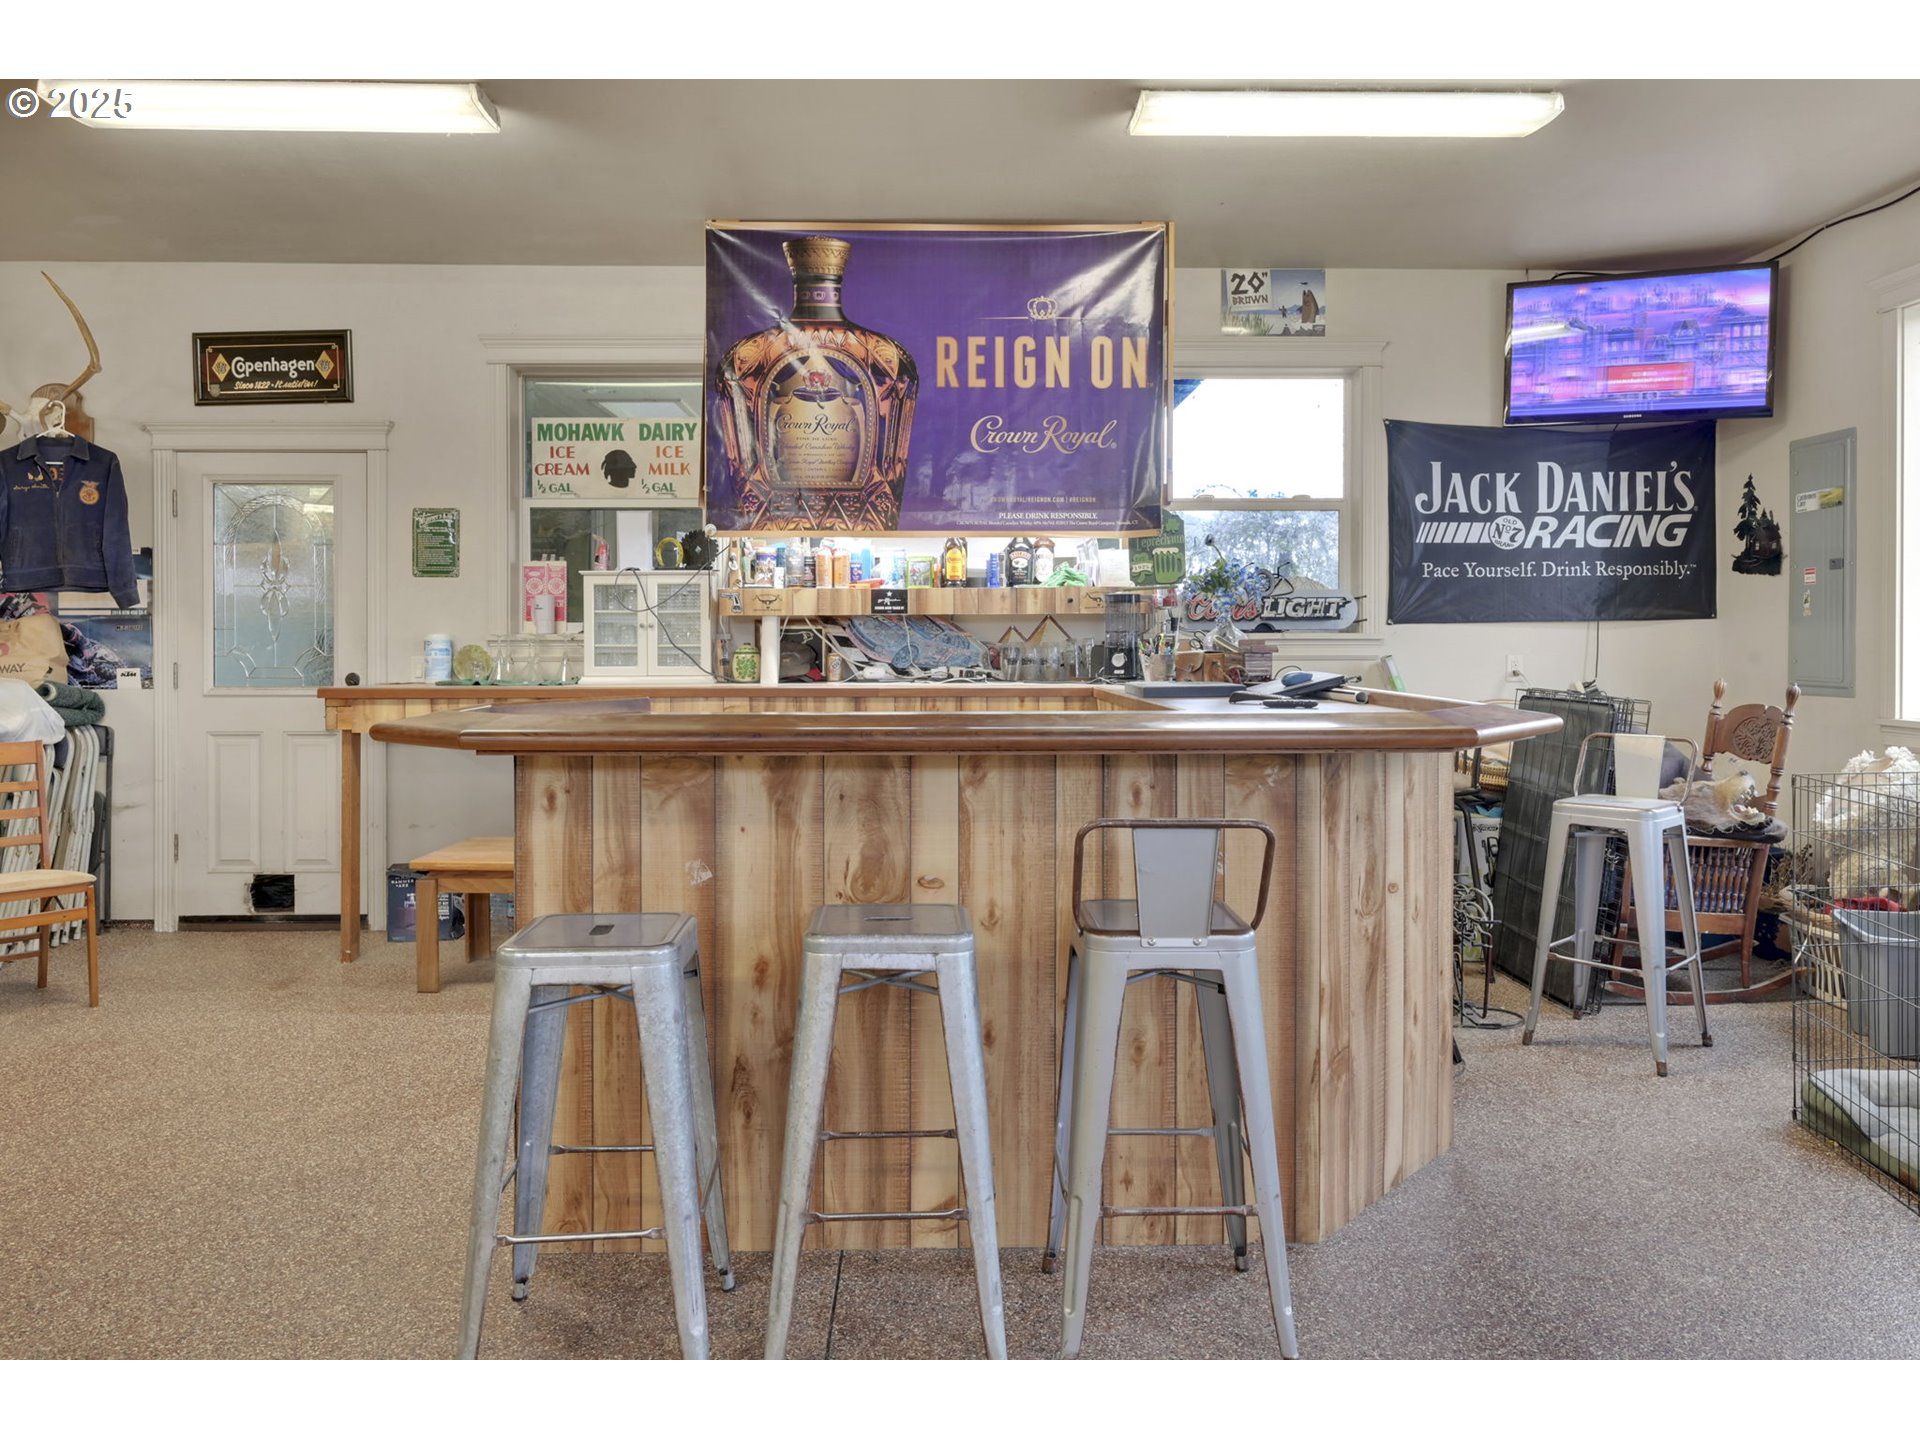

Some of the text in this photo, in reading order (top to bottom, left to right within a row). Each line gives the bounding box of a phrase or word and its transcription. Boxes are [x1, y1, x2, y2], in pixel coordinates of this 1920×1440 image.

[1232, 294, 1269, 306] BROWN
[231, 355, 315, 379] Copenhagen
[935, 335, 1149, 390] REIGN ON
[775, 412, 857, 436] Crown Royal
[536, 422, 698, 442] MOHAWK DAIRY
[969, 414, 1118, 455] Crown Royal
[549, 445, 576, 459] ICE
[655, 445, 685, 459] ICE
[534, 462, 590, 476] CREAM
[648, 462, 691, 476] MILK
[548, 482, 574, 493] GAL
[651, 481, 676, 493] GAL
[998, 512, 1098, 520] PLEASE DRINK RESPONSIBLY.
[1502, 517, 1518, 525] OLD
[1522, 513, 1693, 549] RACING
[1421, 561, 1460, 579] Pace
[1463, 560, 1536, 578] Yourself.
[1541, 560, 1591, 577] Drink
[1261, 596, 1347, 619] LIGHT
